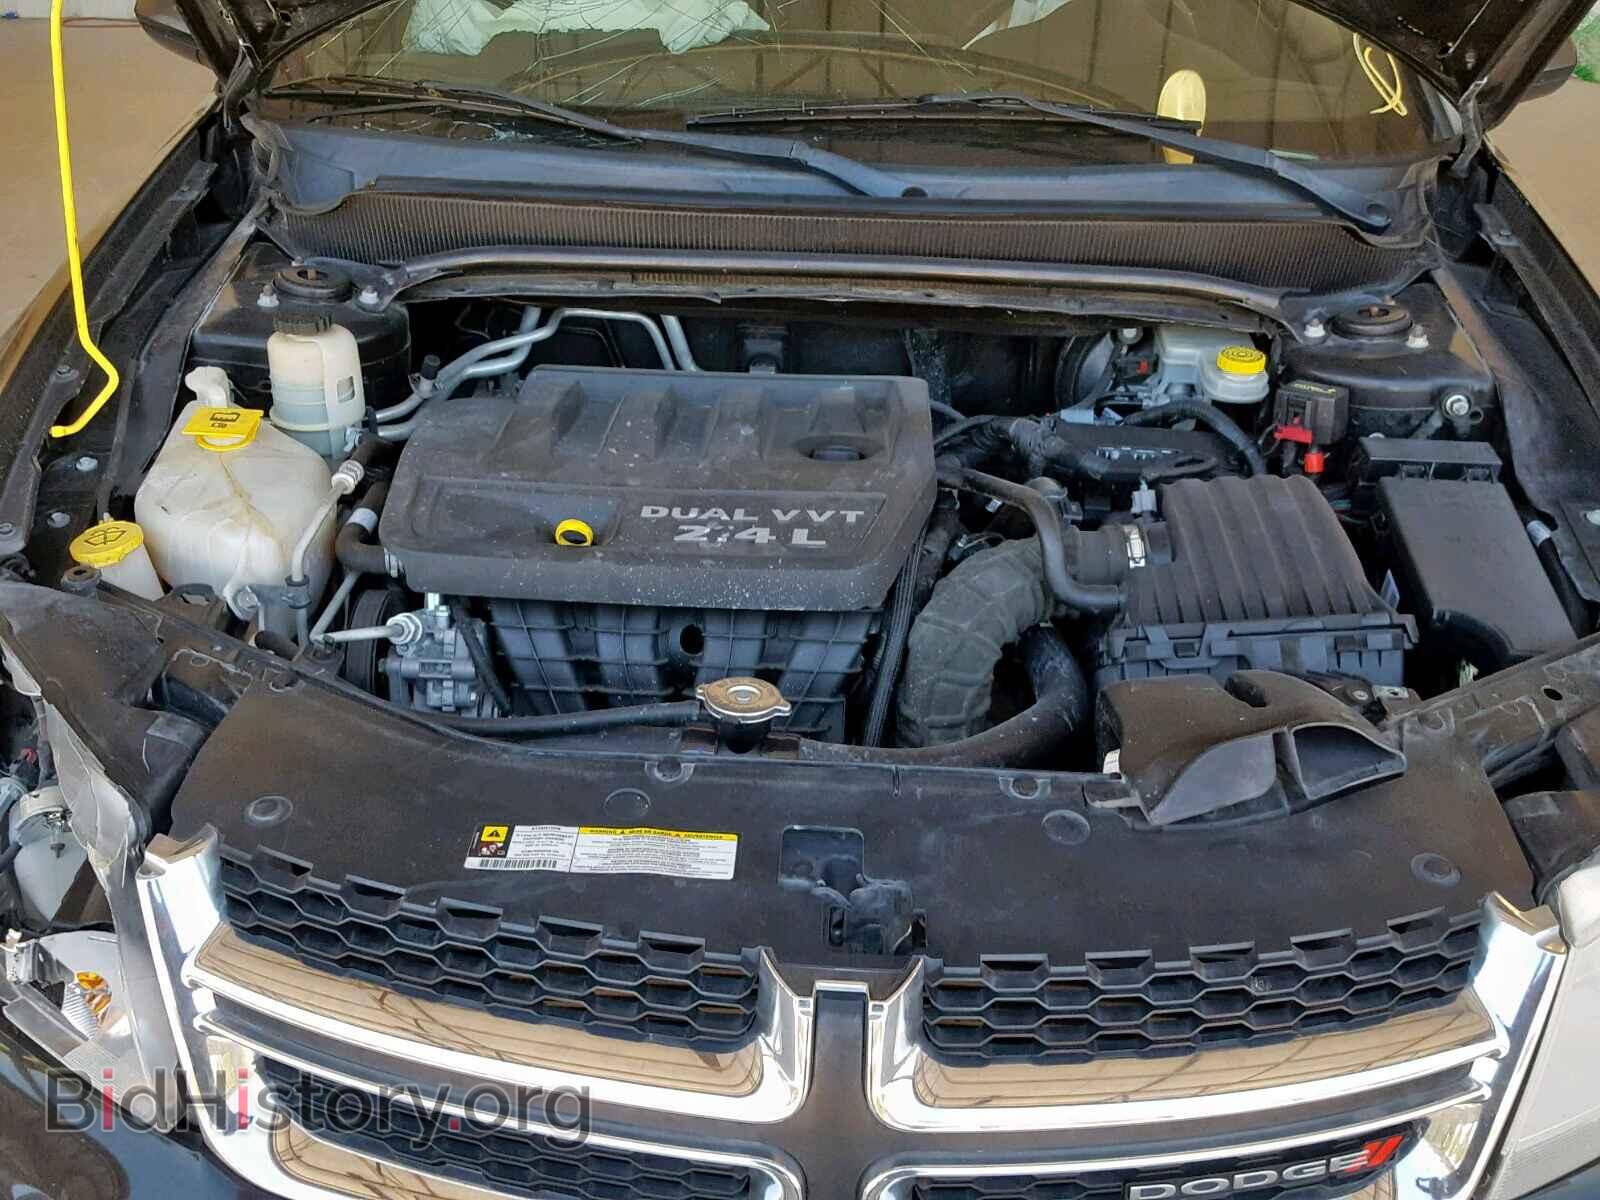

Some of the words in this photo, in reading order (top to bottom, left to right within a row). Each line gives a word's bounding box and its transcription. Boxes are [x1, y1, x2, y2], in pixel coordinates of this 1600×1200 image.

[640, 505, 759, 521] DUAL
[771, 508, 865, 523] VVT
[1129, 1149, 1370, 1200] DODGE
